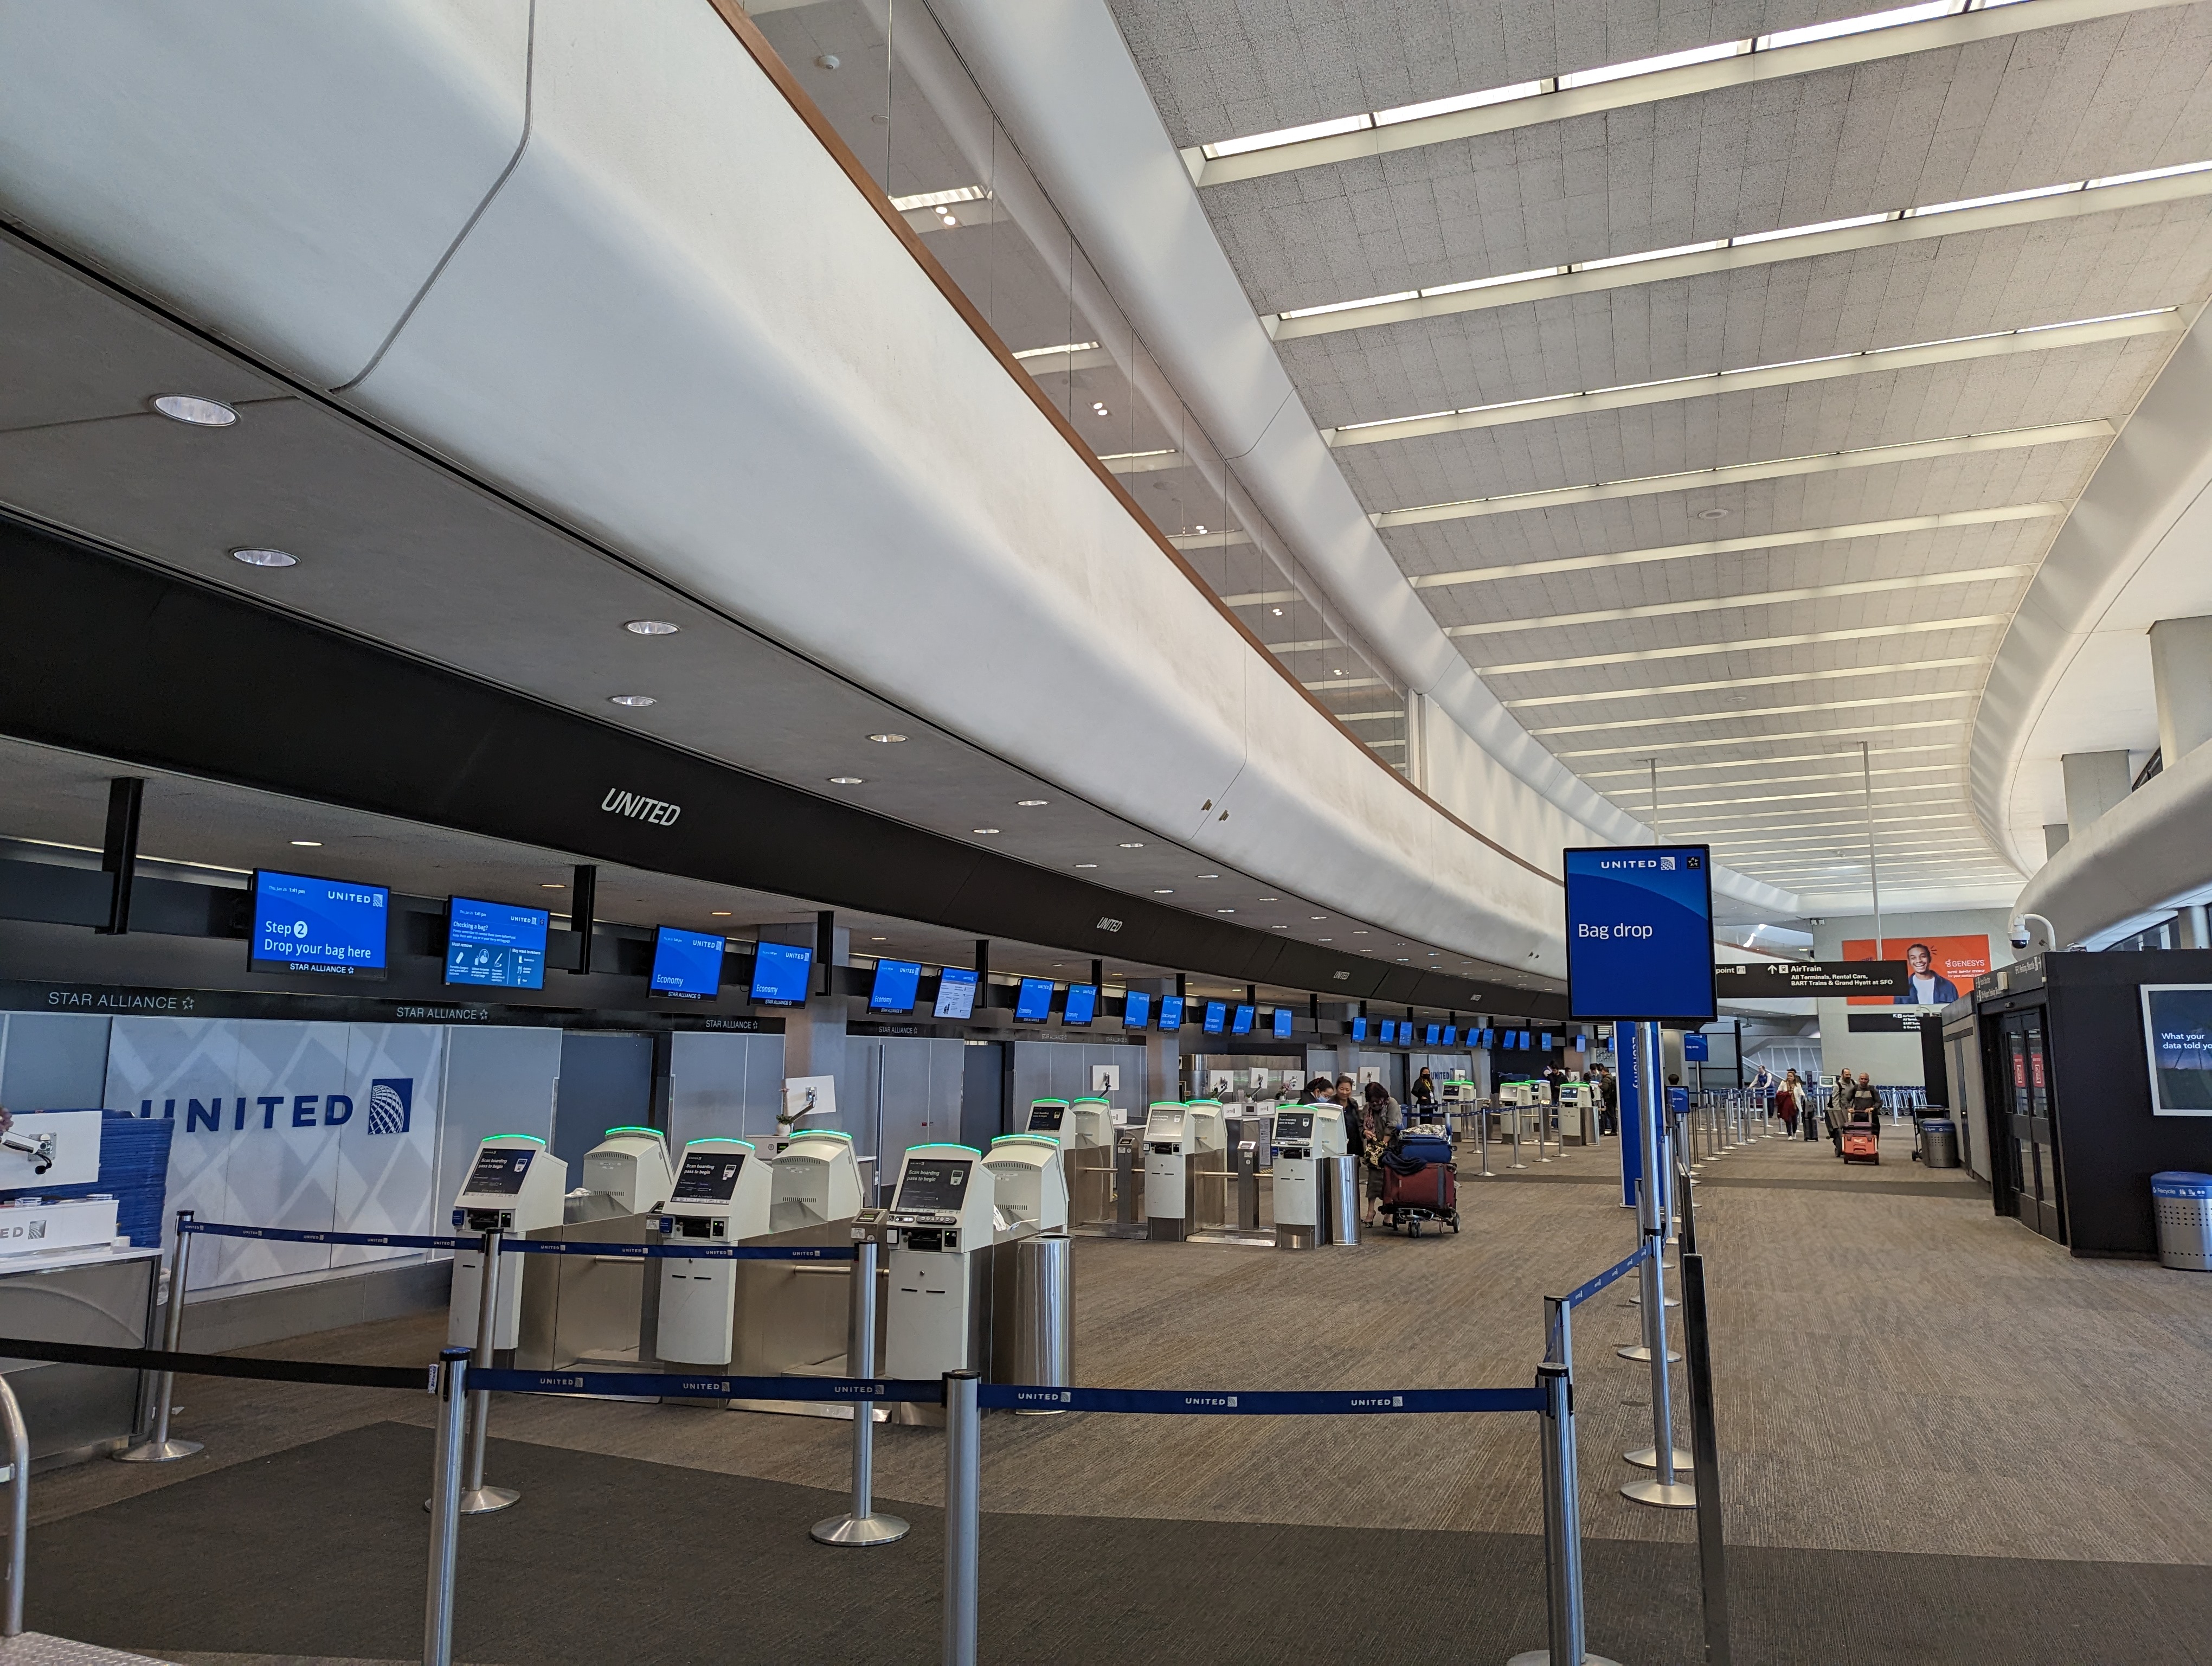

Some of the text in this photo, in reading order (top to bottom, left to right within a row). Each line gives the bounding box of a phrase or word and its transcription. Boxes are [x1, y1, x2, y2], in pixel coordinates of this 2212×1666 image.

[601, 787, 681, 826] UNITED
[327, 891, 371, 904] UNITED
[265, 921, 304, 937] Step 2
[453, 921, 473, 930] Checking
[1096, 917, 1123, 932] UNITED
[1579, 923, 1652, 940] Bag drop
[265, 939, 371, 959] Drop your bag here
[693, 940, 715, 948] UNITED
[311, 964, 346, 973] ALLIANCE
[657, 975, 684, 987] Economy
[756, 984, 778, 995] Economy
[49, 992, 177, 1009] STAR ALLIANCE
[874, 995, 892, 1004] Economy
[396, 1007, 477, 1019] STAR ALLIANCE
[706, 1020, 751, 1029] STAR ALLIANCE
